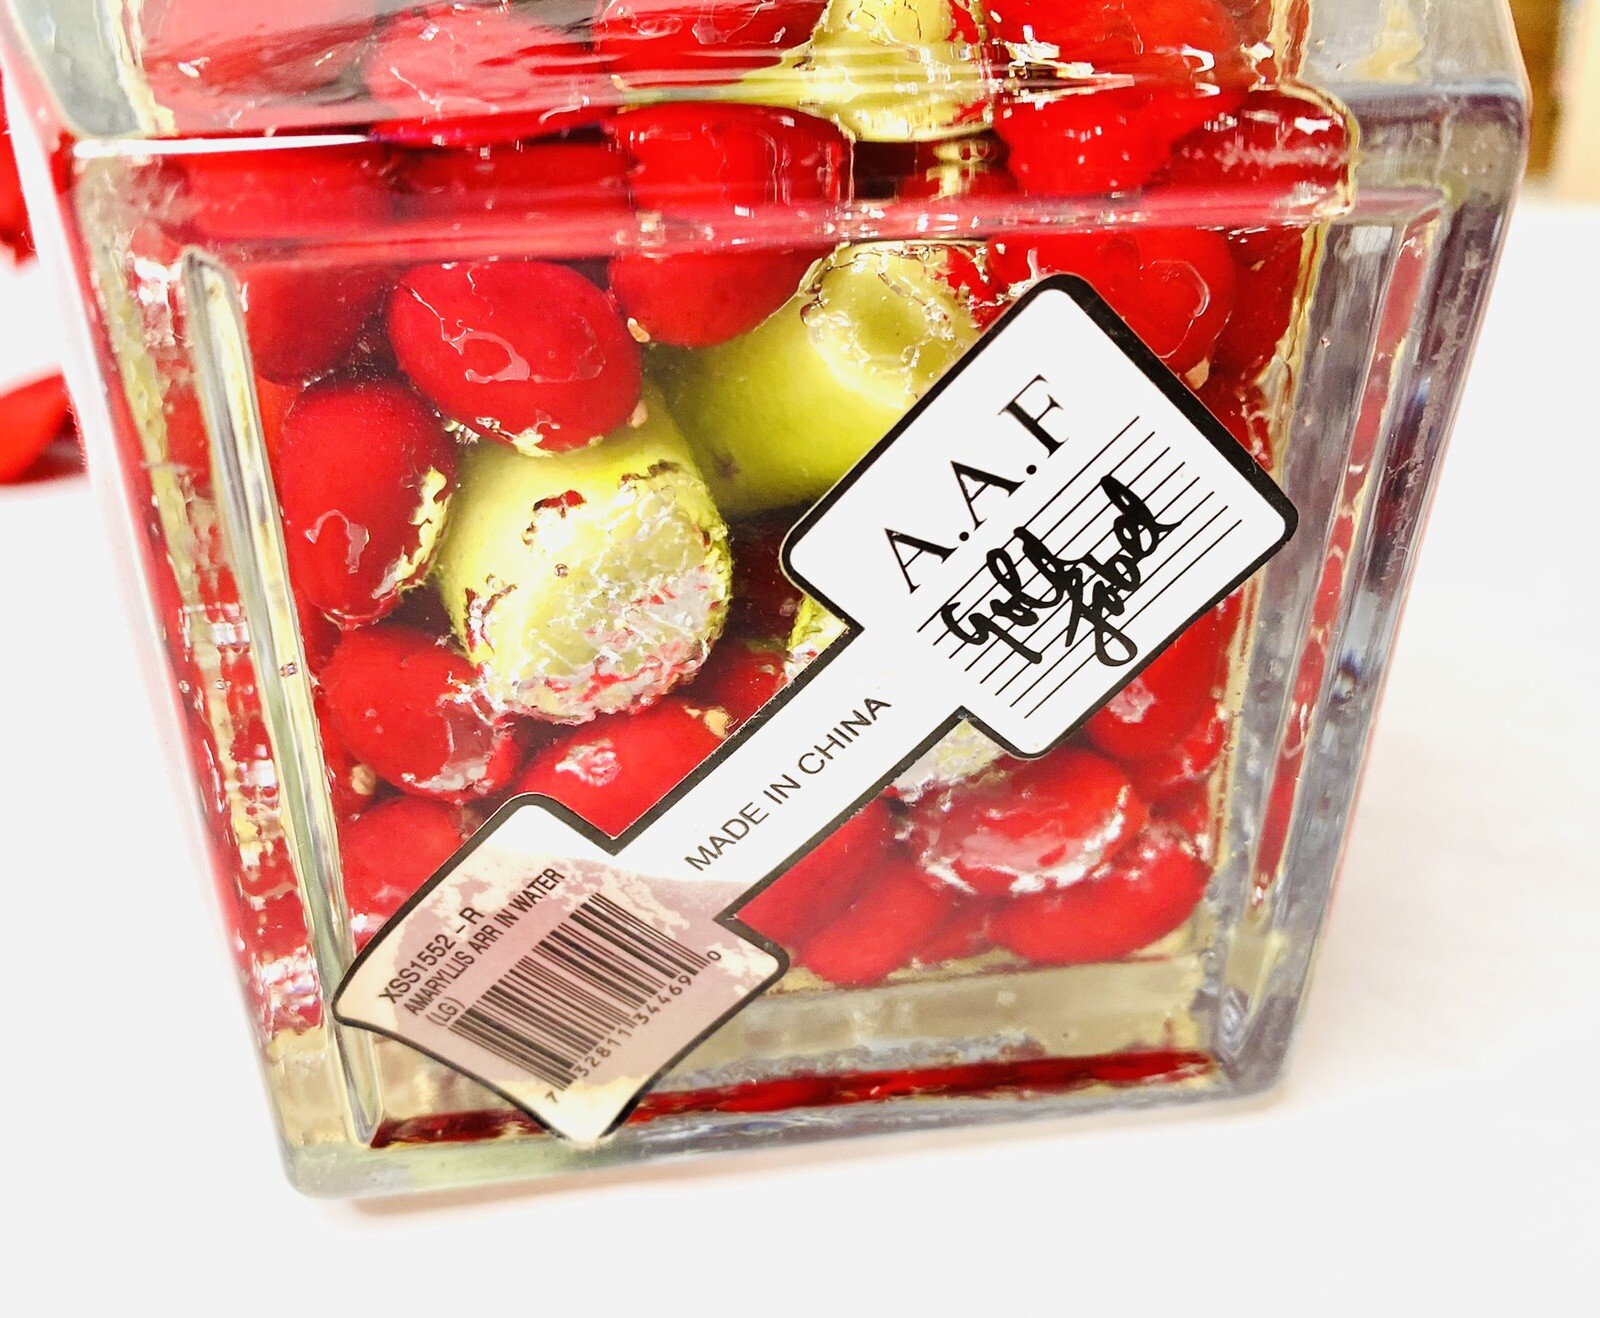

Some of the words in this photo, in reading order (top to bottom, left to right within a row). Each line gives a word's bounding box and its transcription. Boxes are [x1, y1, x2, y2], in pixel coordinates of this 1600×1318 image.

[883, 374, 1069, 595] A.A.F
[684, 802, 769, 871] MADE
[763, 774, 801, 804] IN
[798, 698, 892, 774] CHINA
[378, 933, 457, 1004] XSS1552
[403, 951, 475, 1016] AMARYLLIS
[467, 924, 504, 955] ARR
[493, 908, 519, 928] IN
[508, 867, 565, 913] WATER
[425, 996, 466, 1027] (LG)
[573, 1027, 633, 1078] 32811
[632, 974, 692, 1026] 34469
